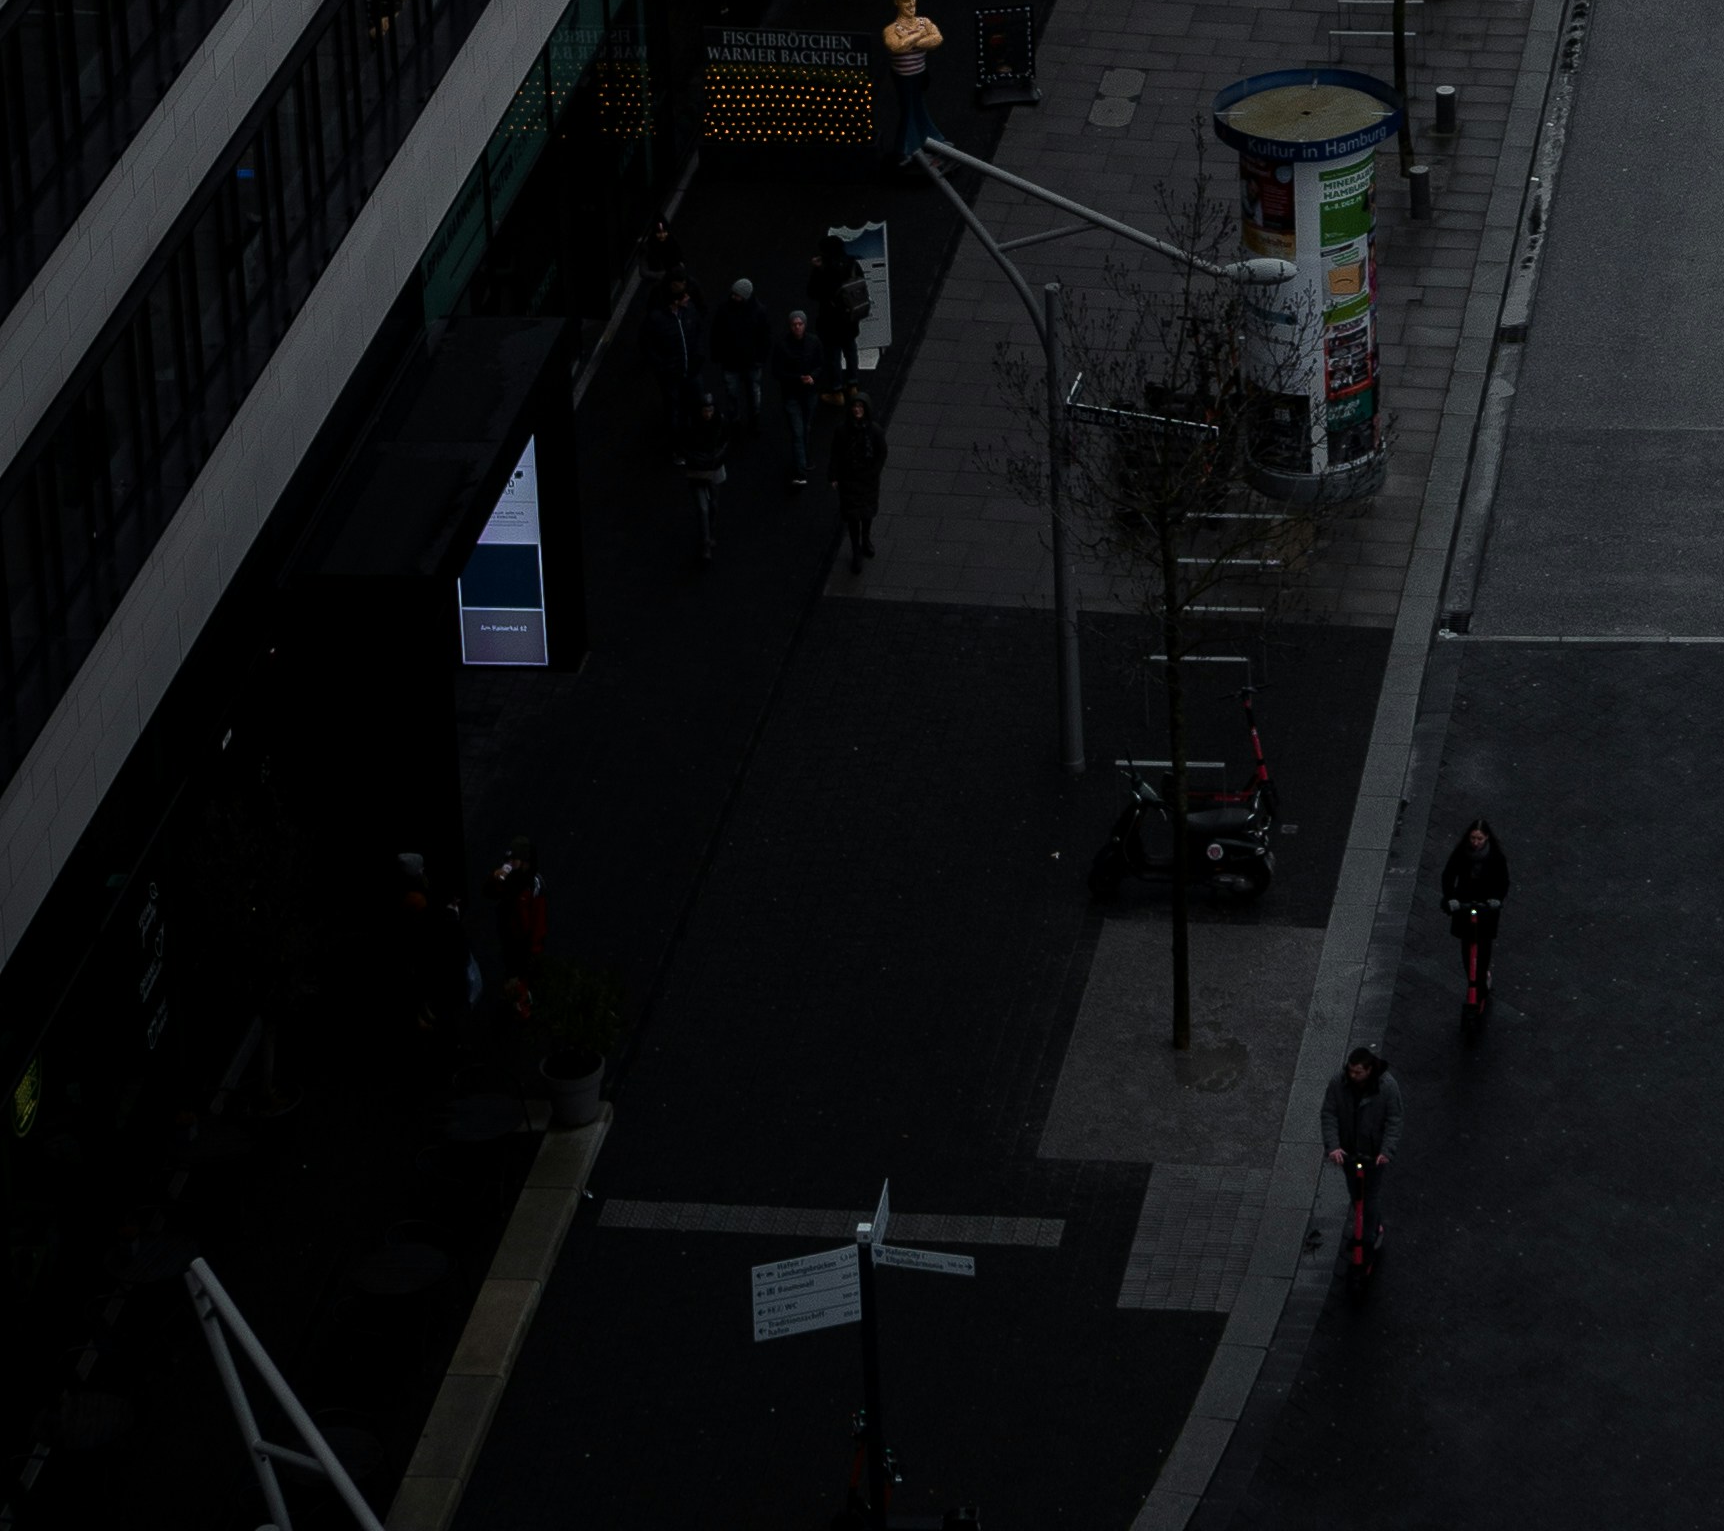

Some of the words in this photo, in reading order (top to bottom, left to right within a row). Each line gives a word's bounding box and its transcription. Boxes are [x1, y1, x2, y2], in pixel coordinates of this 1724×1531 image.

[722, 30, 853, 51] FISCHBRÖTCHEN
[706, 46, 777, 64] WARMER
[780, 49, 869, 67] BACKFISCH
[1246, 136, 1296, 159] Kultur
[1302, 145, 1319, 159] in
[1325, 125, 1388, 157] Hamburg
